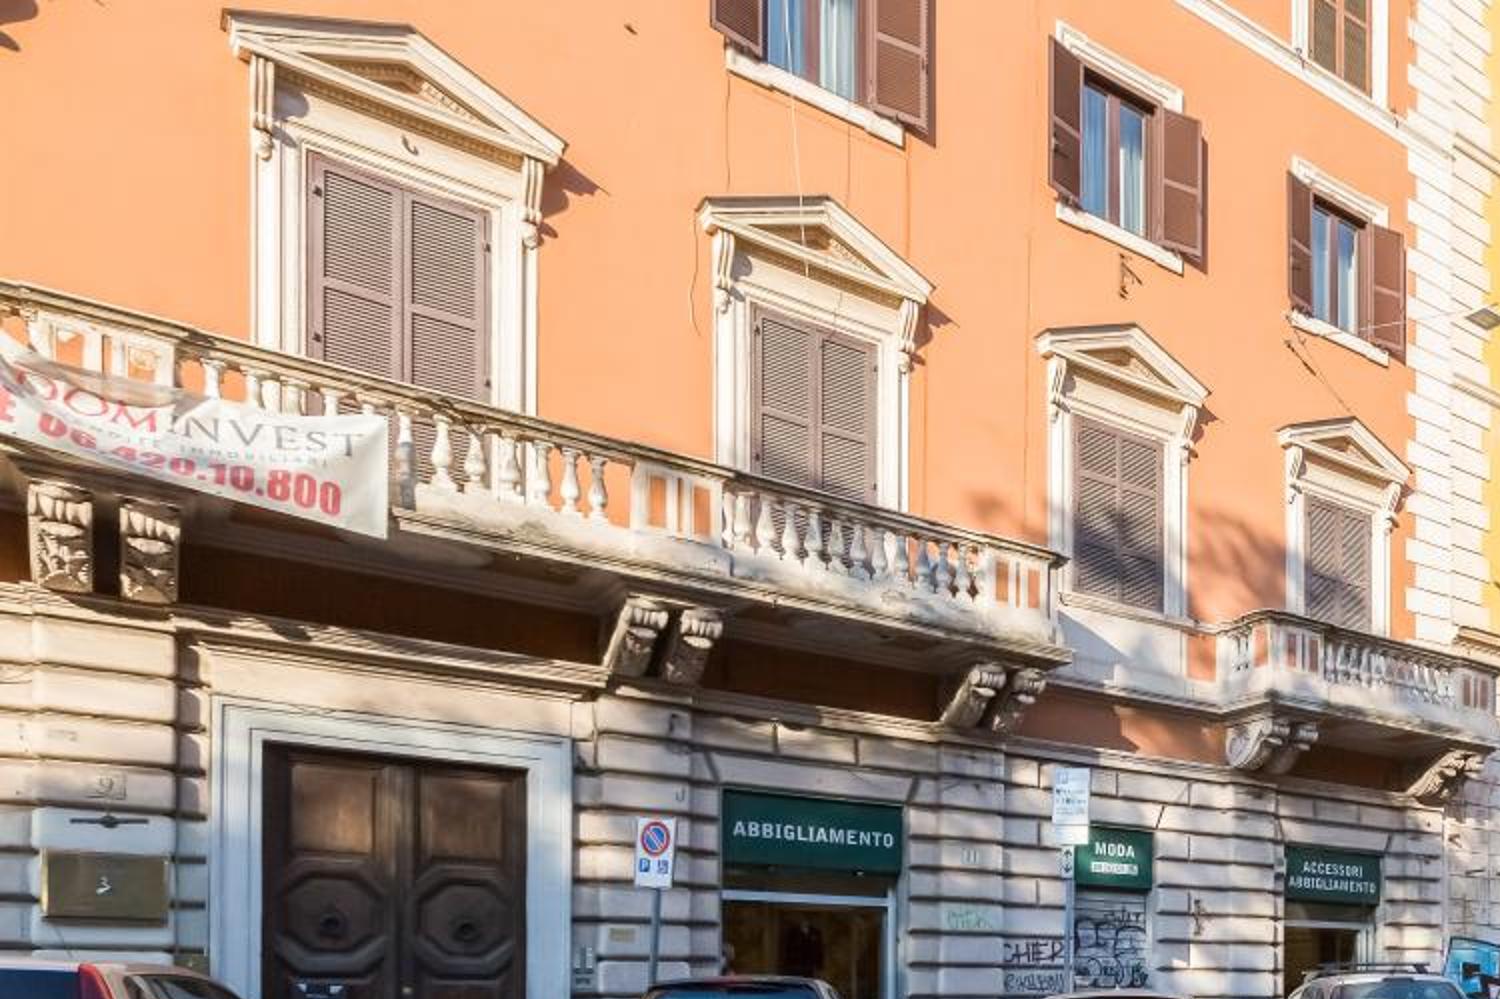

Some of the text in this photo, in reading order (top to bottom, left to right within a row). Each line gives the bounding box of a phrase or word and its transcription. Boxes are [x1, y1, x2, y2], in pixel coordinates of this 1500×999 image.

[733, 820, 895, 848] ABBIGLIAMENTO
[1095, 842, 1136, 858] MODA
[1303, 861, 1363, 879] ACCESSORI
[1288, 875, 1377, 895] ABBIGLIAMENTO
